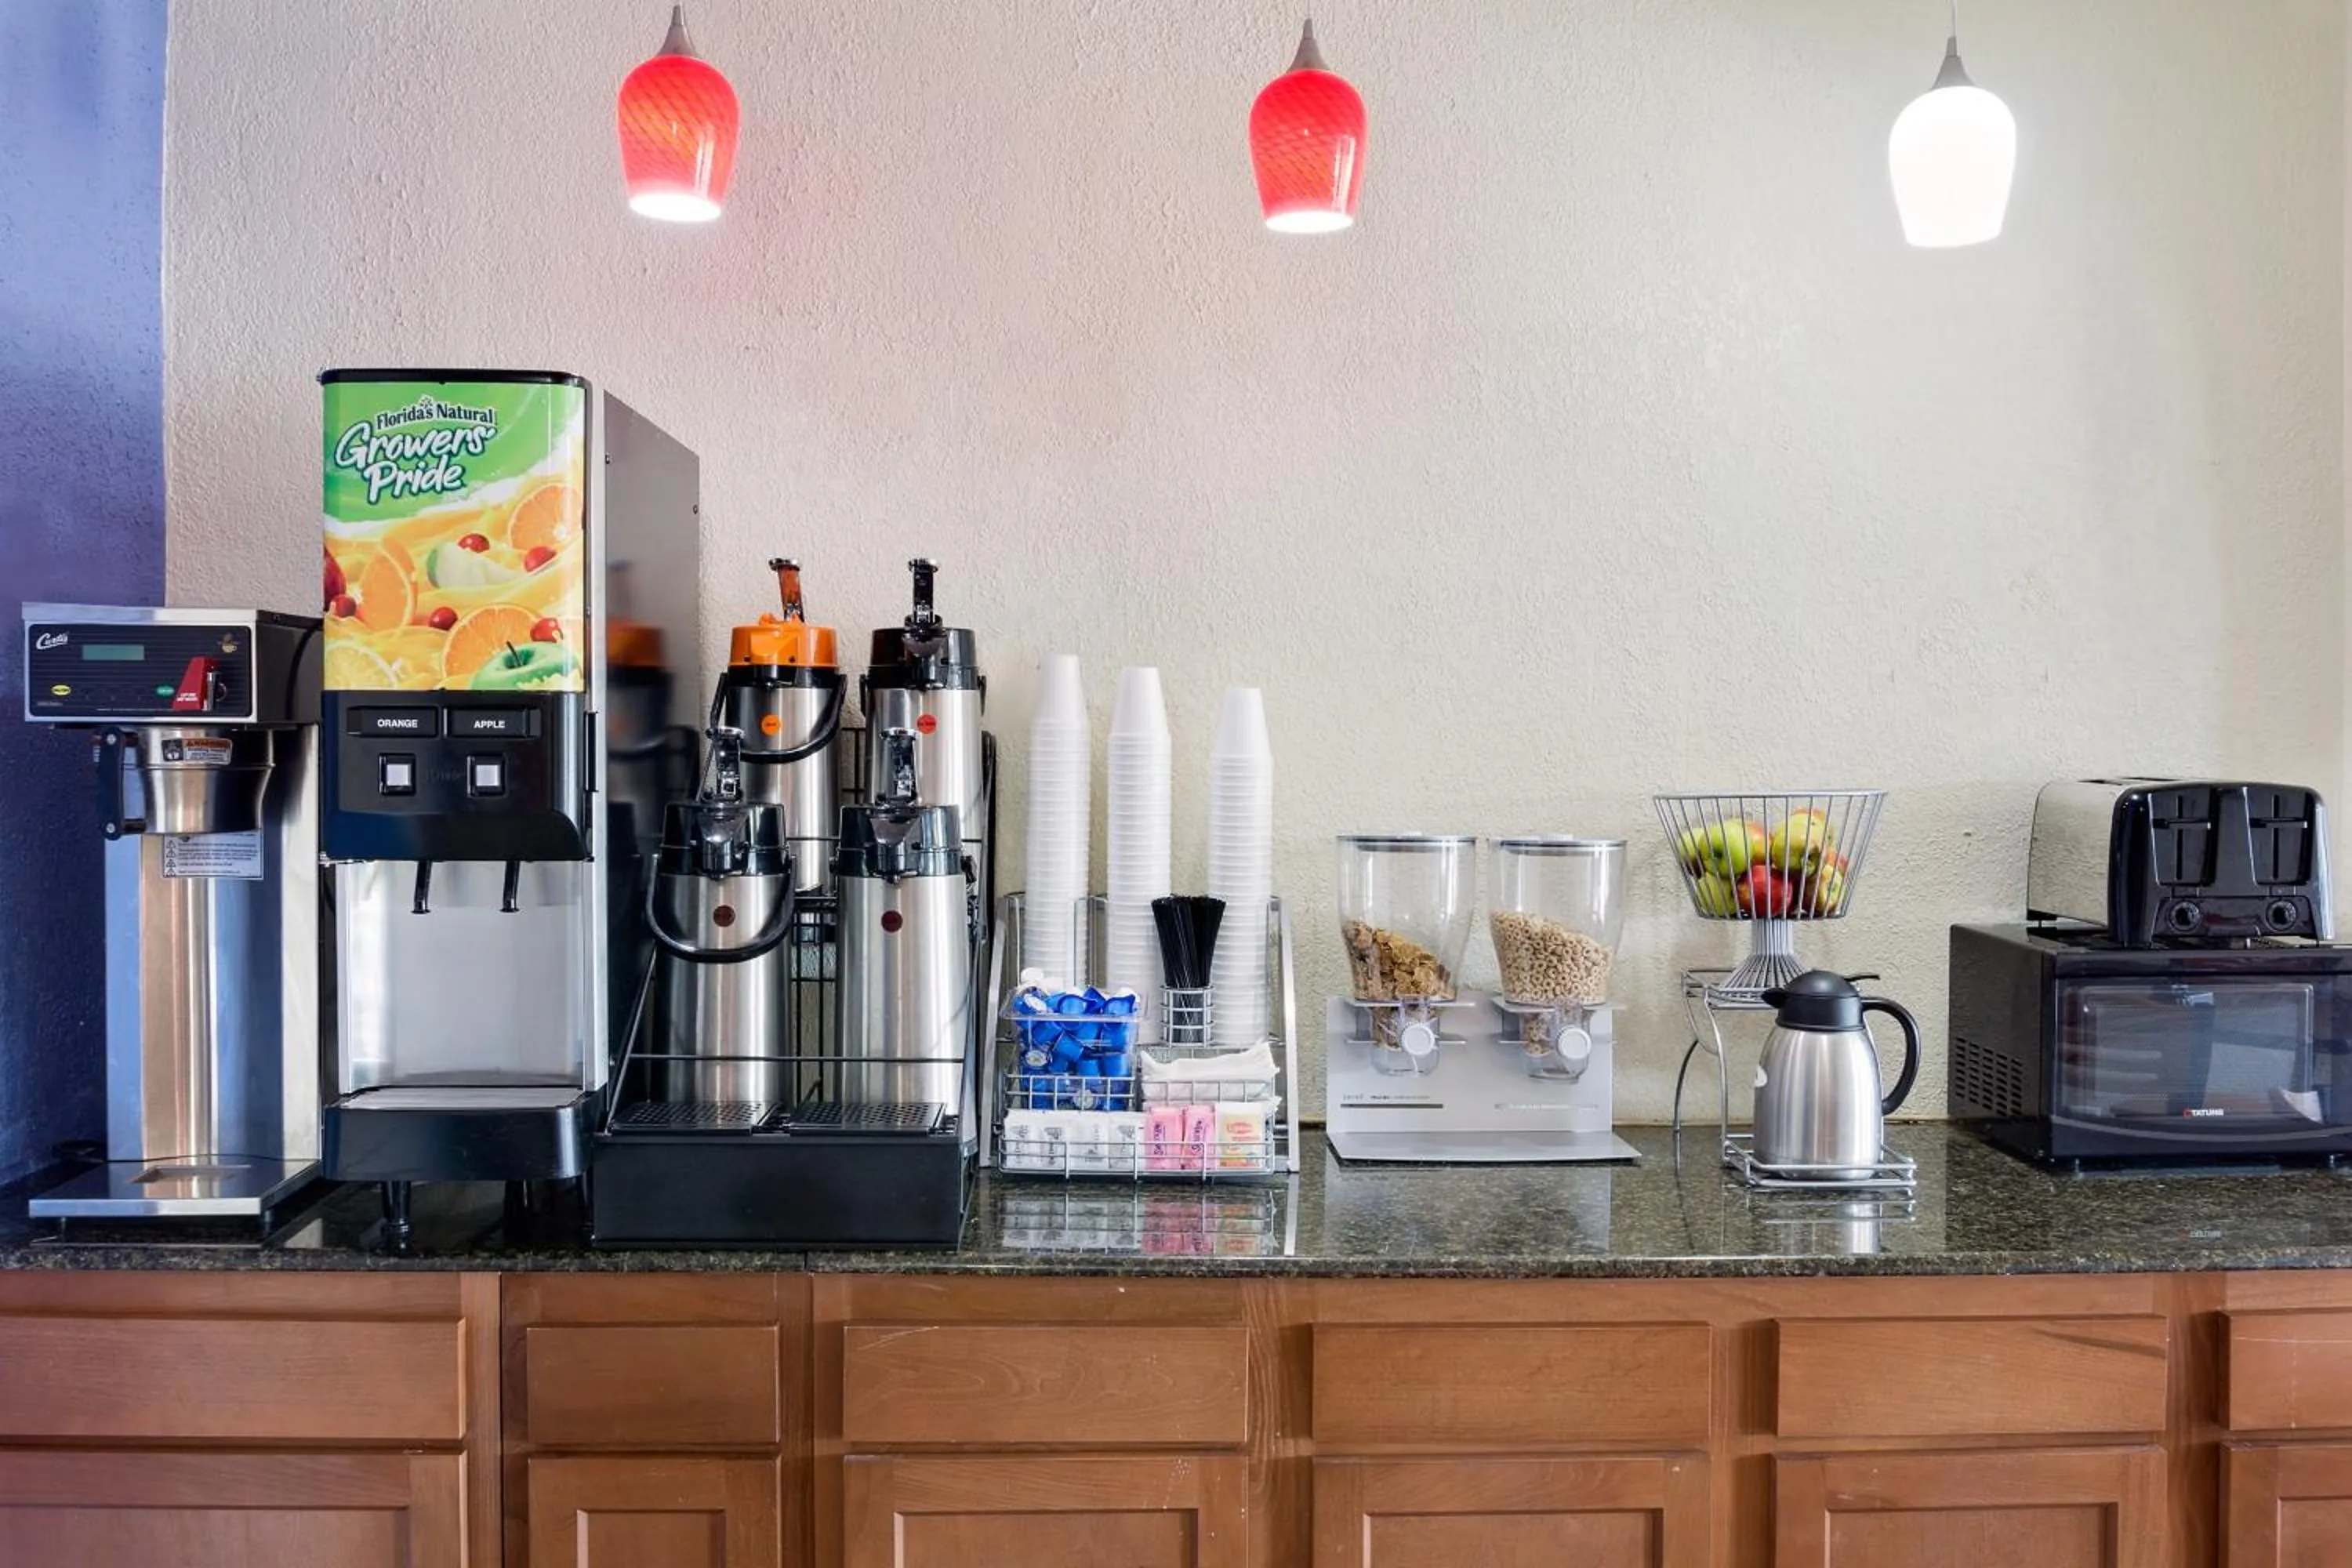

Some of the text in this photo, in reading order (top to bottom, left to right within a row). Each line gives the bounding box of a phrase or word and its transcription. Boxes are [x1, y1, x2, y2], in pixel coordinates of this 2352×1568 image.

[436, 403, 494, 423] Natural
[363, 452, 467, 506] Pride
[377, 719, 419, 728] ORANGE
[474, 720, 506, 728] APPLE
